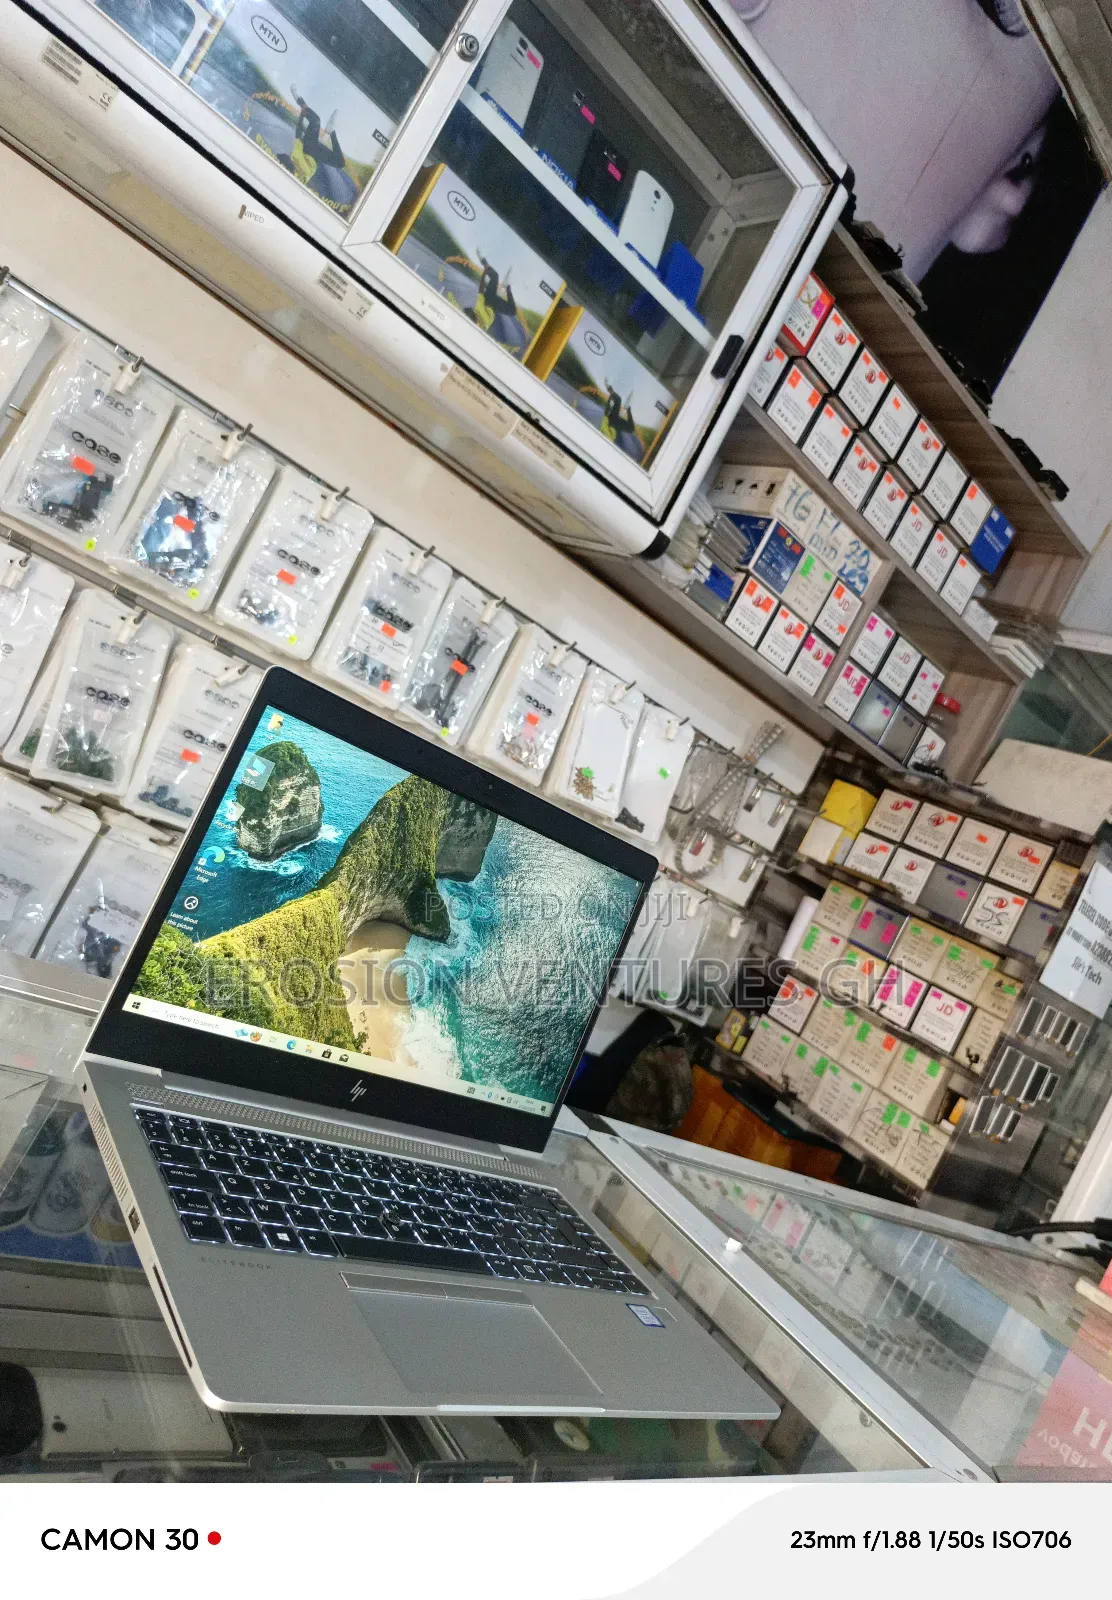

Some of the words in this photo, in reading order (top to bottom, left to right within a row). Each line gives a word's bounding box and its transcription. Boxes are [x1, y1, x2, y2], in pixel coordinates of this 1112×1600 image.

[259, 24, 280, 46] MTN
[452, 196, 470, 216] MTN
[588, 335, 603, 352] MTN
[71, 431, 122, 464] case
[277, 548, 321, 576] case
[86, 686, 131, 708] case
[525, 694, 553, 717] case
[183, 729, 229, 753] case
[194, 866, 218, 878] Microsoft
[196, 874, 210, 884] Edge
[167, 919, 177, 927] this
[176, 920, 194, 931] picture
[170, 911, 183, 920] Learn
[184, 914, 198, 924] about
[1085, 964, 1103, 986] Tech
[936, 1003, 955, 1017] JD
[350, 1079, 368, 1102] hp
[200, 1256, 273, 1270] ELITEBOOK
